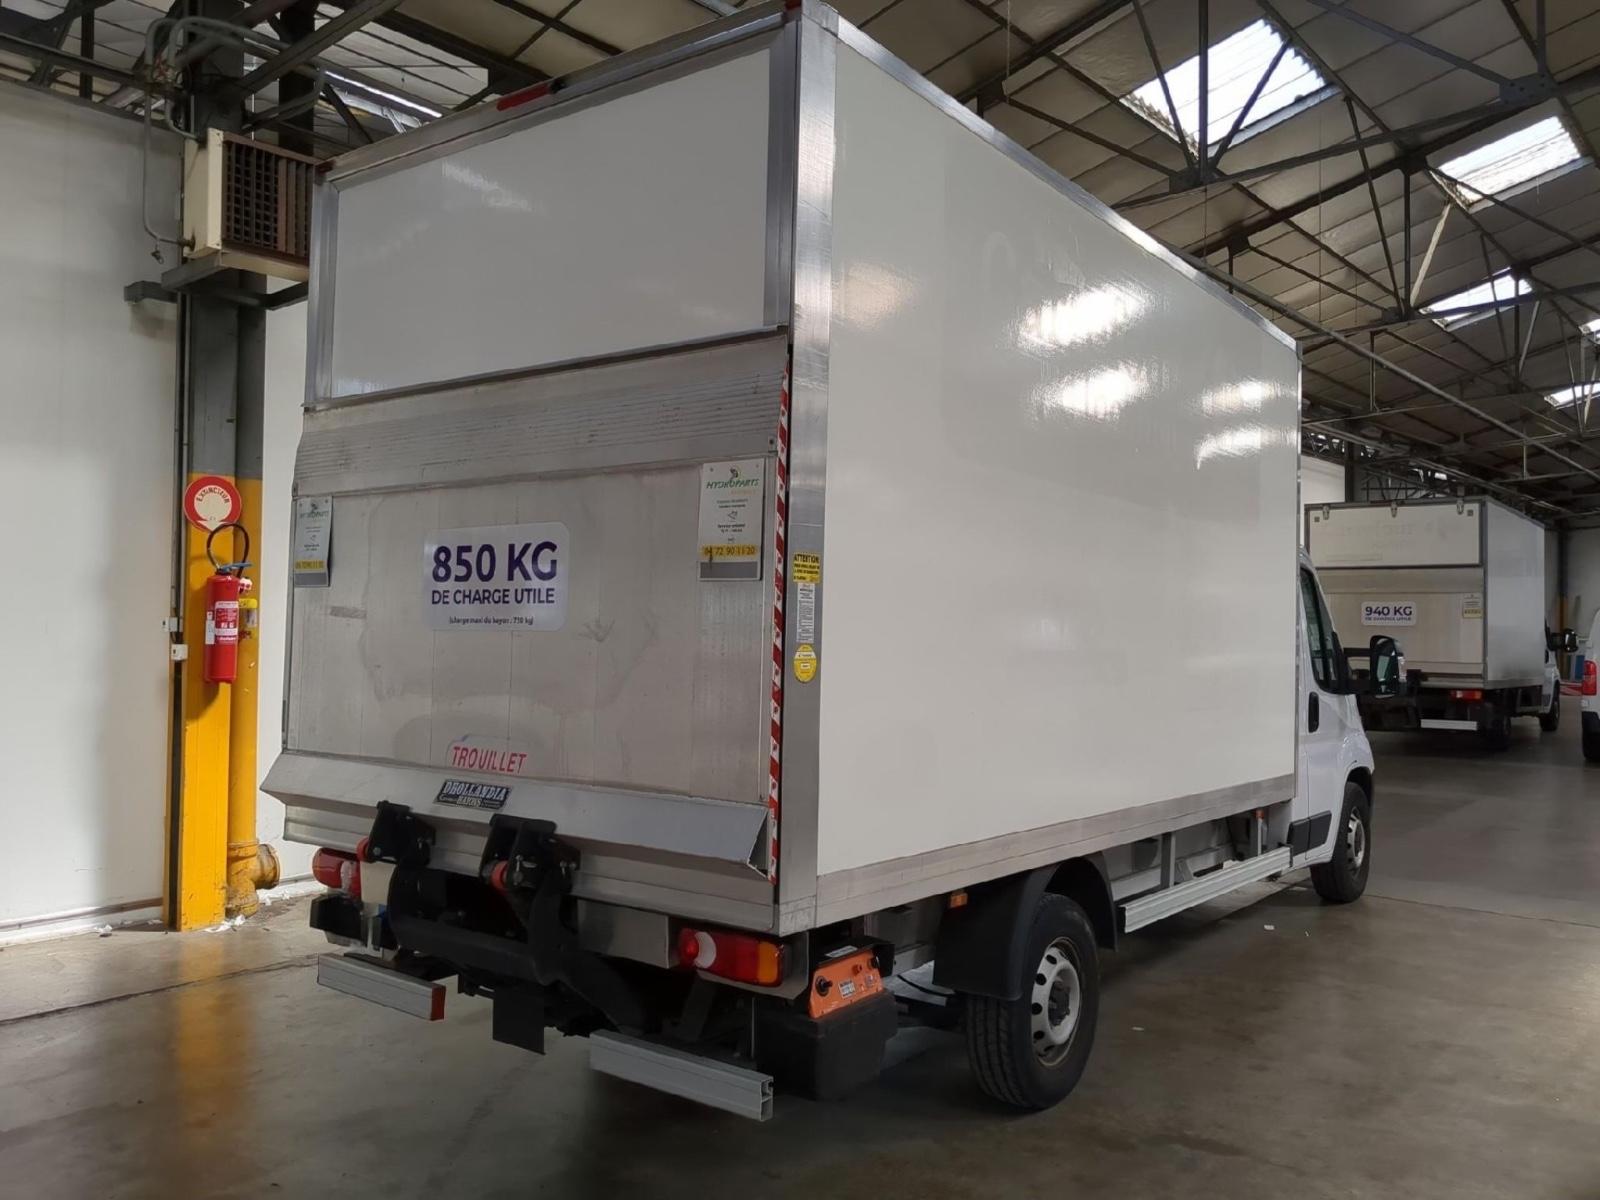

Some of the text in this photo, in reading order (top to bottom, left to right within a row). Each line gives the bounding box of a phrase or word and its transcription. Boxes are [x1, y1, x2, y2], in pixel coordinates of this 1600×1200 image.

[432, 541, 557, 582] 850 KG
[432, 588, 555, 605] DE CHARGE UTILE
[1365, 606, 1413, 616] 940 KG
[452, 746, 528, 773] TROUILLET
[443, 781, 508, 800] DHOLLANDIA
